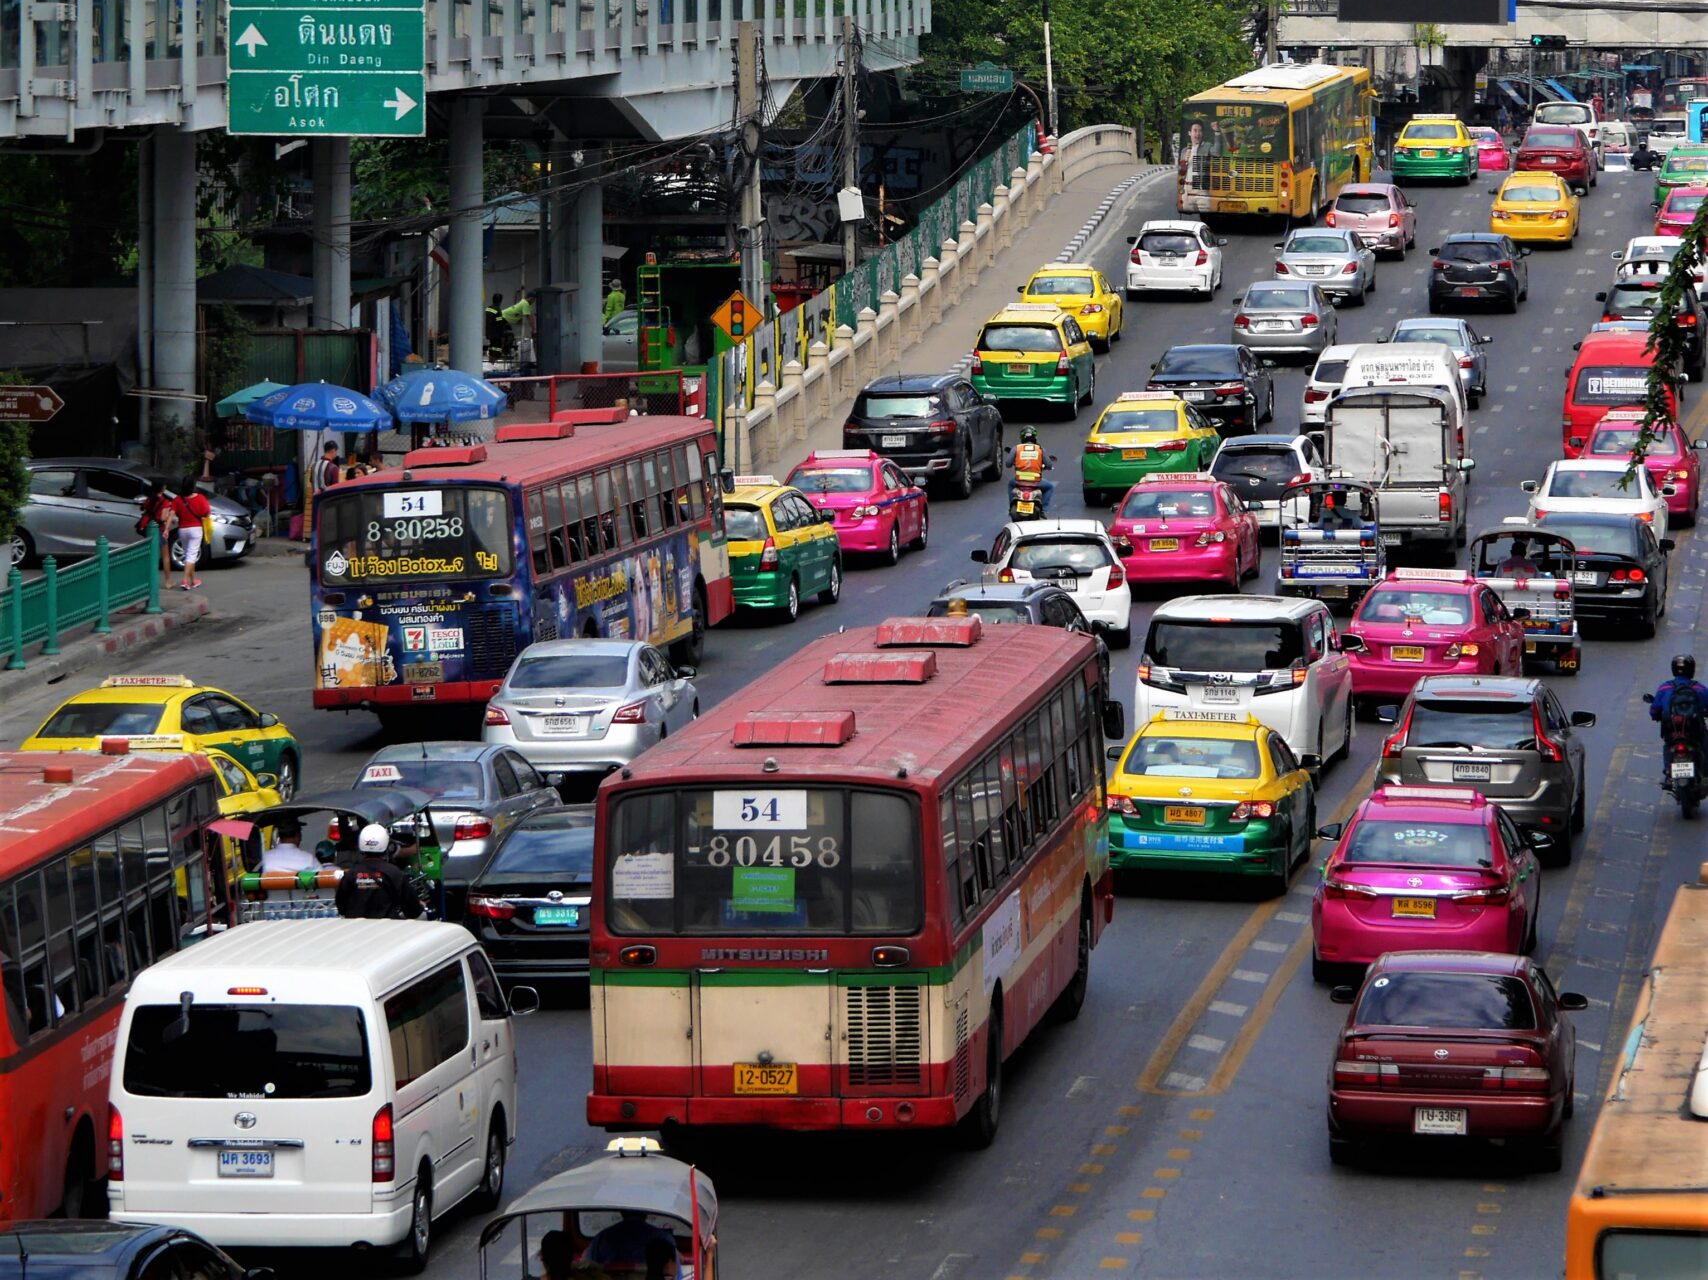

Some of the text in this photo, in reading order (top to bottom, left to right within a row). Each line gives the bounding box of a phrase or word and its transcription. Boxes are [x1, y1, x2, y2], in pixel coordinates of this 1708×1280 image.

[299, 15, 392, 45] ดินแดง
[308, 53, 382, 67] Din Daeng
[274, 74, 339, 108] อโศก
[289, 117, 325, 127] Asok
[401, 496, 425, 513] 54
[367, 517, 464, 542] 8-80258
[1174, 710, 1237, 721] TAXI-METER
[369, 767, 393, 778] TAXI
[741, 797, 782, 823] 54
[701, 948, 829, 961] MITSUBISHI
[740, 1070, 794, 1085] 12-0527
[242, 1153, 271, 1165] 3693
